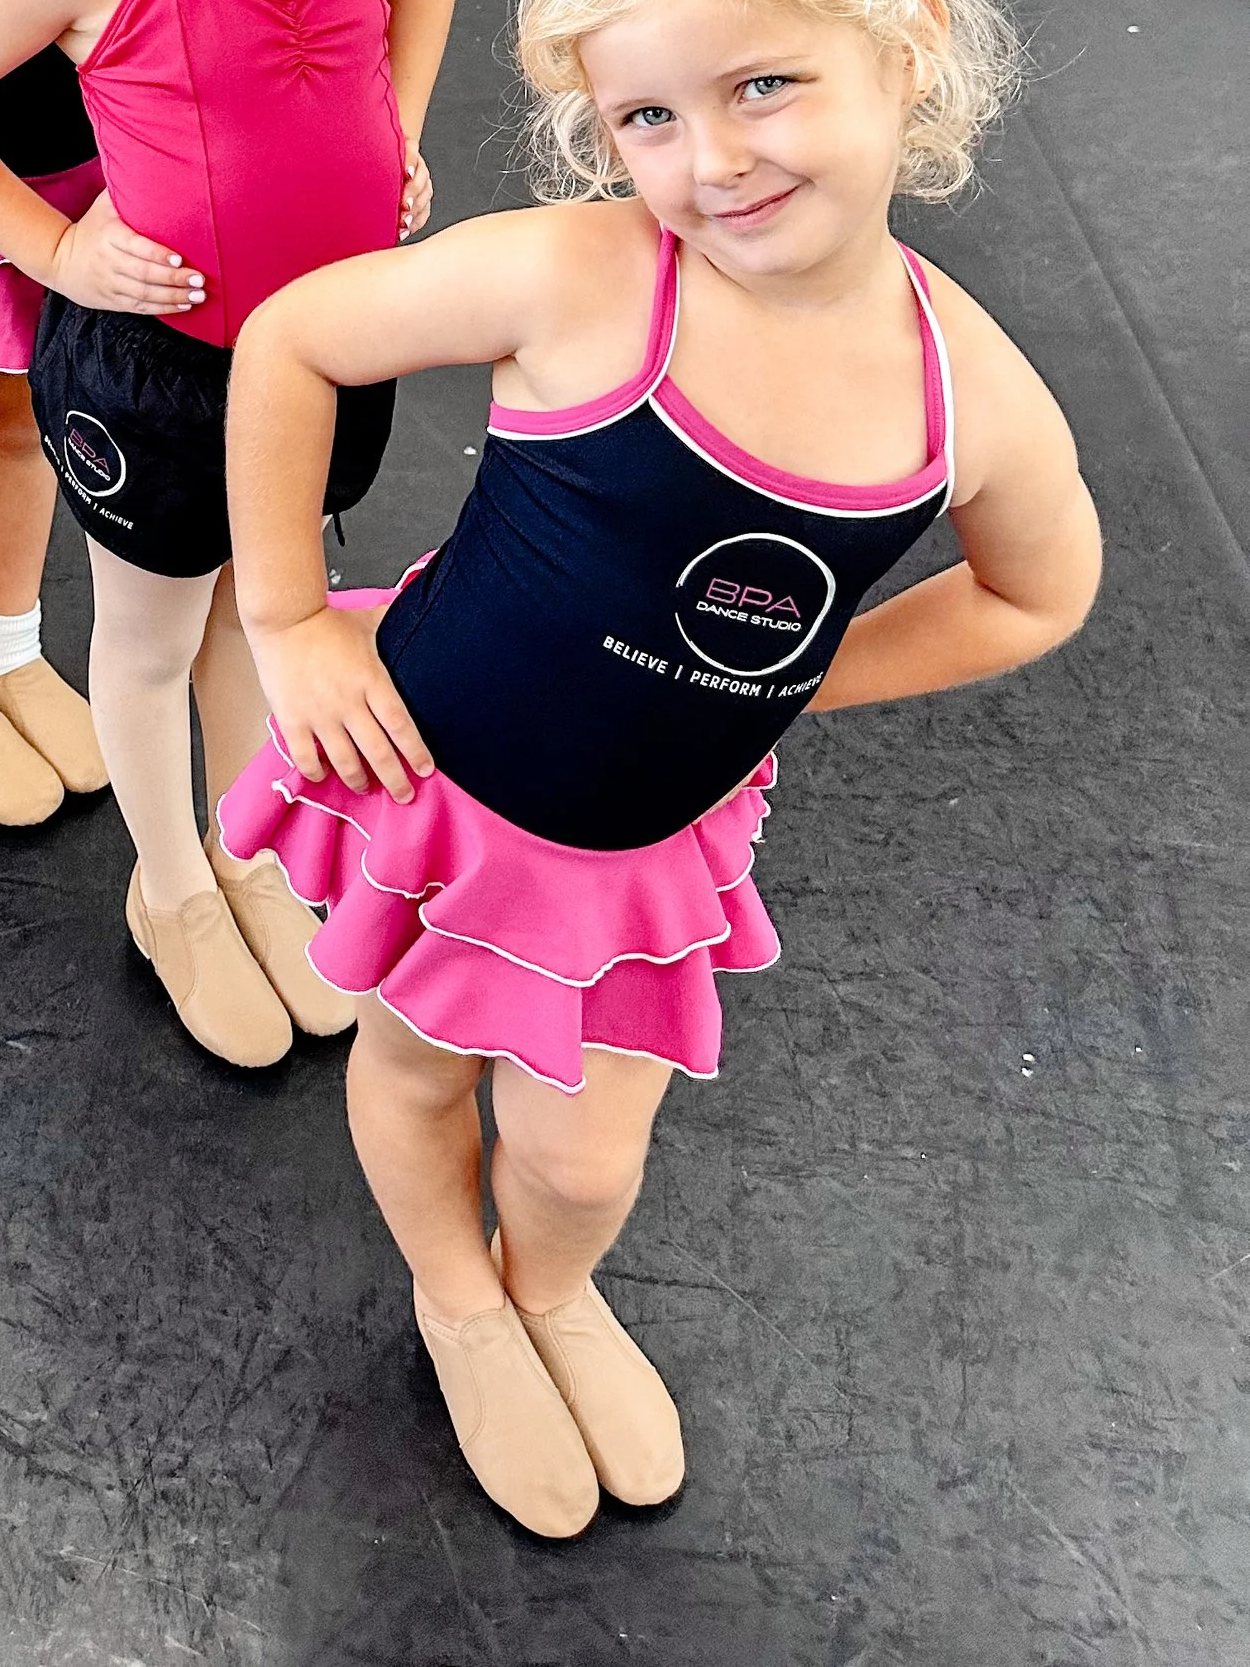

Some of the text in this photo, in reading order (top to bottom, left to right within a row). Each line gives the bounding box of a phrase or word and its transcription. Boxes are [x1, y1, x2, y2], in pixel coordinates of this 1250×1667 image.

[85, 459, 111, 482] STUDIO
[64, 471, 92, 505] PERFORM
[99, 507, 134, 530] ACHIEVE
[696, 601, 801, 632] DANCE STUDIO
[705, 577, 801, 618] BPA
[603, 635, 668, 674] BELIEVE
[689, 670, 762, 697] PERFORM
